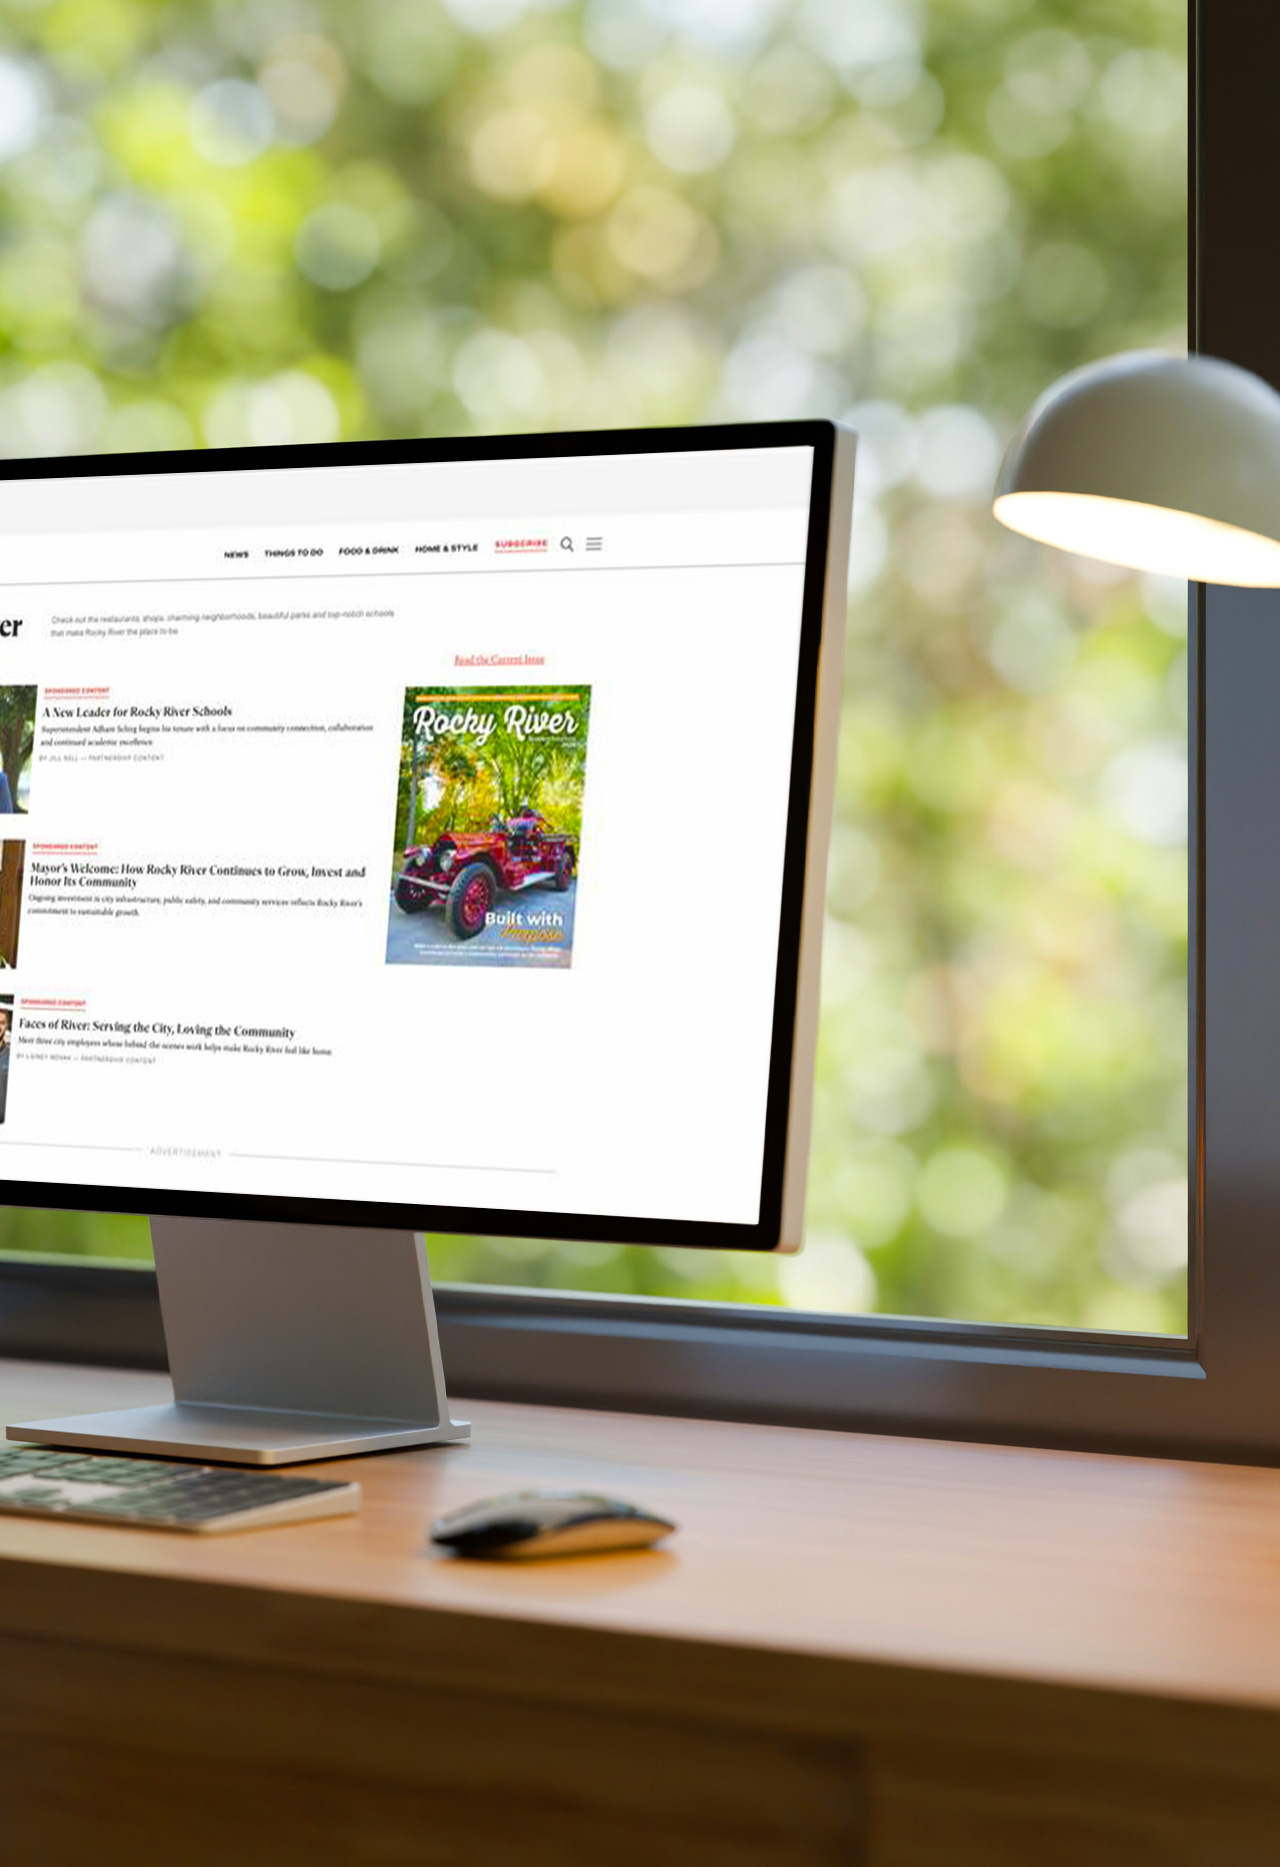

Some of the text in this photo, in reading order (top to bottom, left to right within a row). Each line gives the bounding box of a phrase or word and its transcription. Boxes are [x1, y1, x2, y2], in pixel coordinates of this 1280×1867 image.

[415, 545, 442, 553] HOME
[451, 543, 479, 552] STYLE
[495, 539, 548, 548] SUBSCRIBE
[224, 551, 249, 559] NEWS
[264, 548, 324, 558] THINGS TO DO
[339, 547, 363, 556] FOOD
[372, 546, 399, 555] DRINK
[312, 610, 327, 619] and
[454, 655, 476, 666] Read
[476, 655, 488, 666] the
[490, 654, 523, 666] Current
[43, 705, 232, 720] A New Leader for Rocky River Schools
[246, 724, 285, 733] community
[413, 705, 579, 745] Rocky River
[40, 738, 53, 747] and
[70, 863, 119, 875] Welcome:
[121, 863, 144, 875] How
[146, 864, 177, 878] Rocky
[180, 864, 207, 876] River
[209, 865, 262, 876] Continues
[264, 866, 276, 876] to
[278, 865, 309, 879] Grow,
[311, 866, 343, 877] Invest
[345, 866, 366, 878] and
[30, 875, 138, 890] Honor Its Community
[485, 911, 563, 926] Built with
[19, 1018, 296, 1041] Faces of River: Serving the City, Loving the Community
[149, 1146, 221, 1159] ADVERTISEMENT
